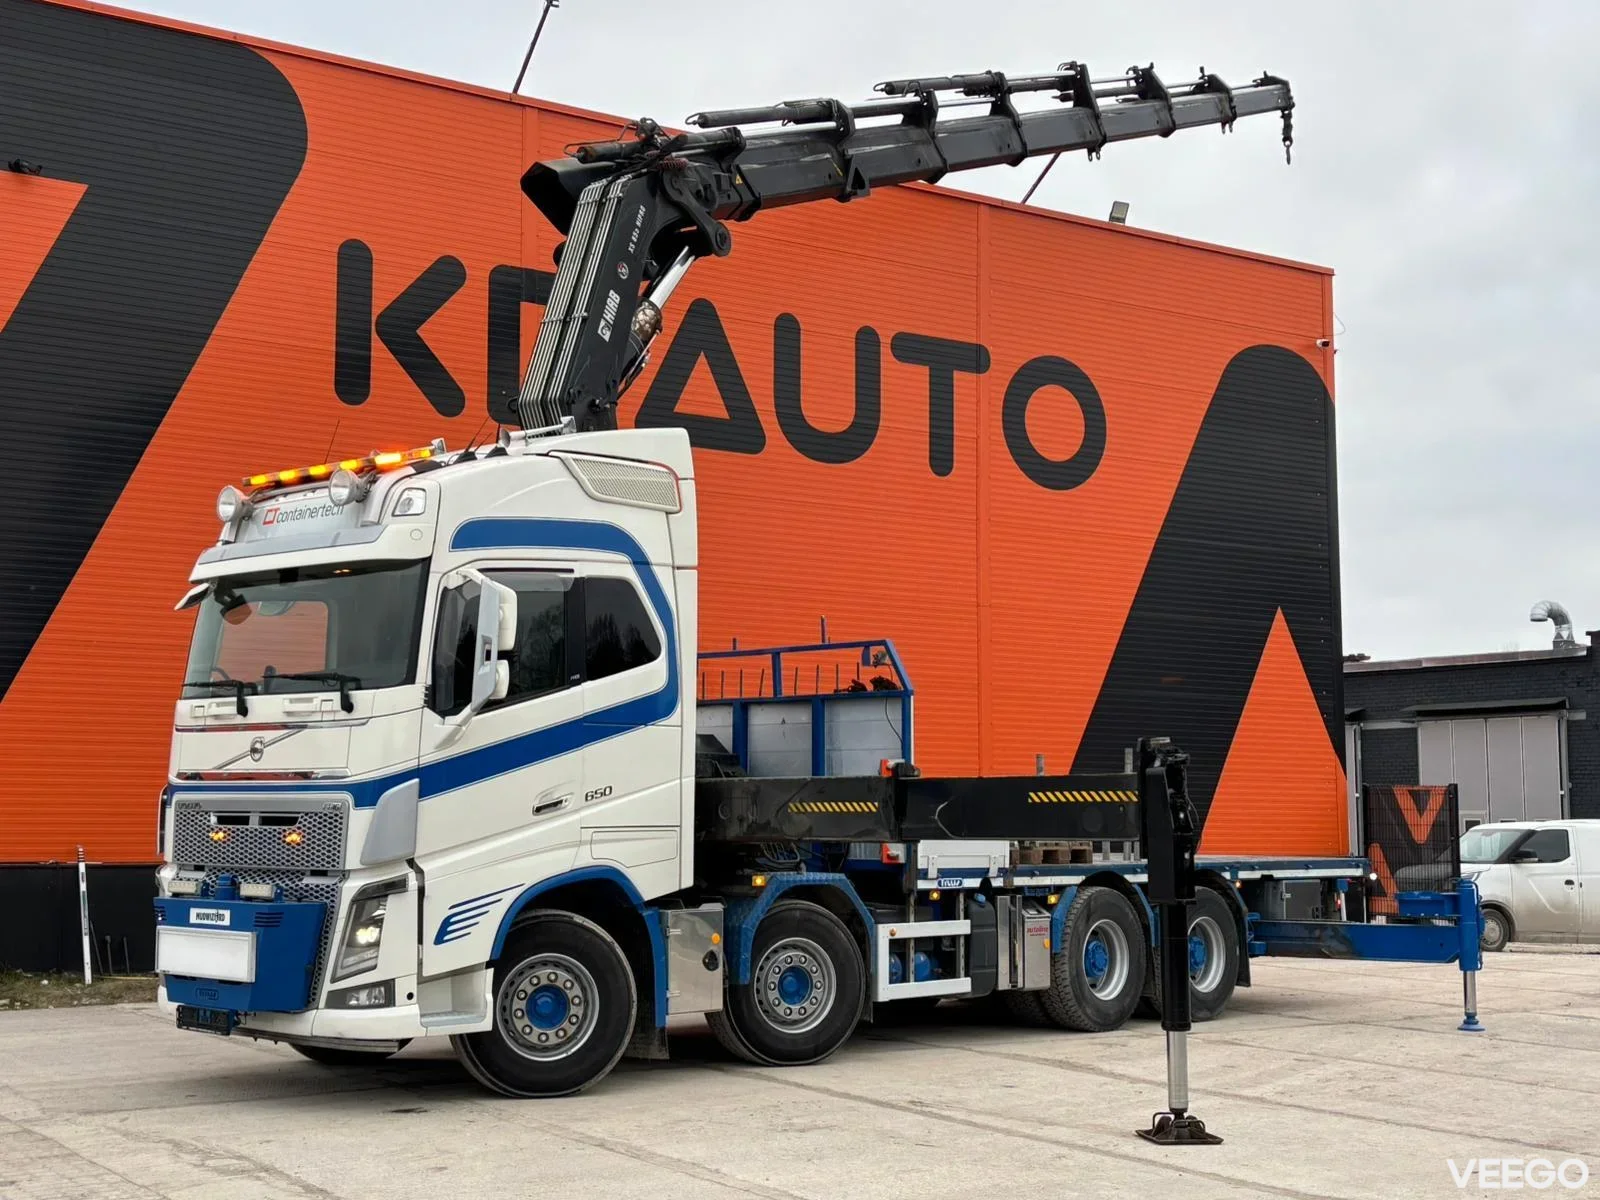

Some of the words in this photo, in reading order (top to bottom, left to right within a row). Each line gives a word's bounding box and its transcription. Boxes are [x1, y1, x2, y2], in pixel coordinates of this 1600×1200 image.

[603, 289, 620, 325] HIAB
[635, 298, 1107, 490] AUTO
[276, 503, 345, 524] containertech
[585, 785, 613, 802] 650
